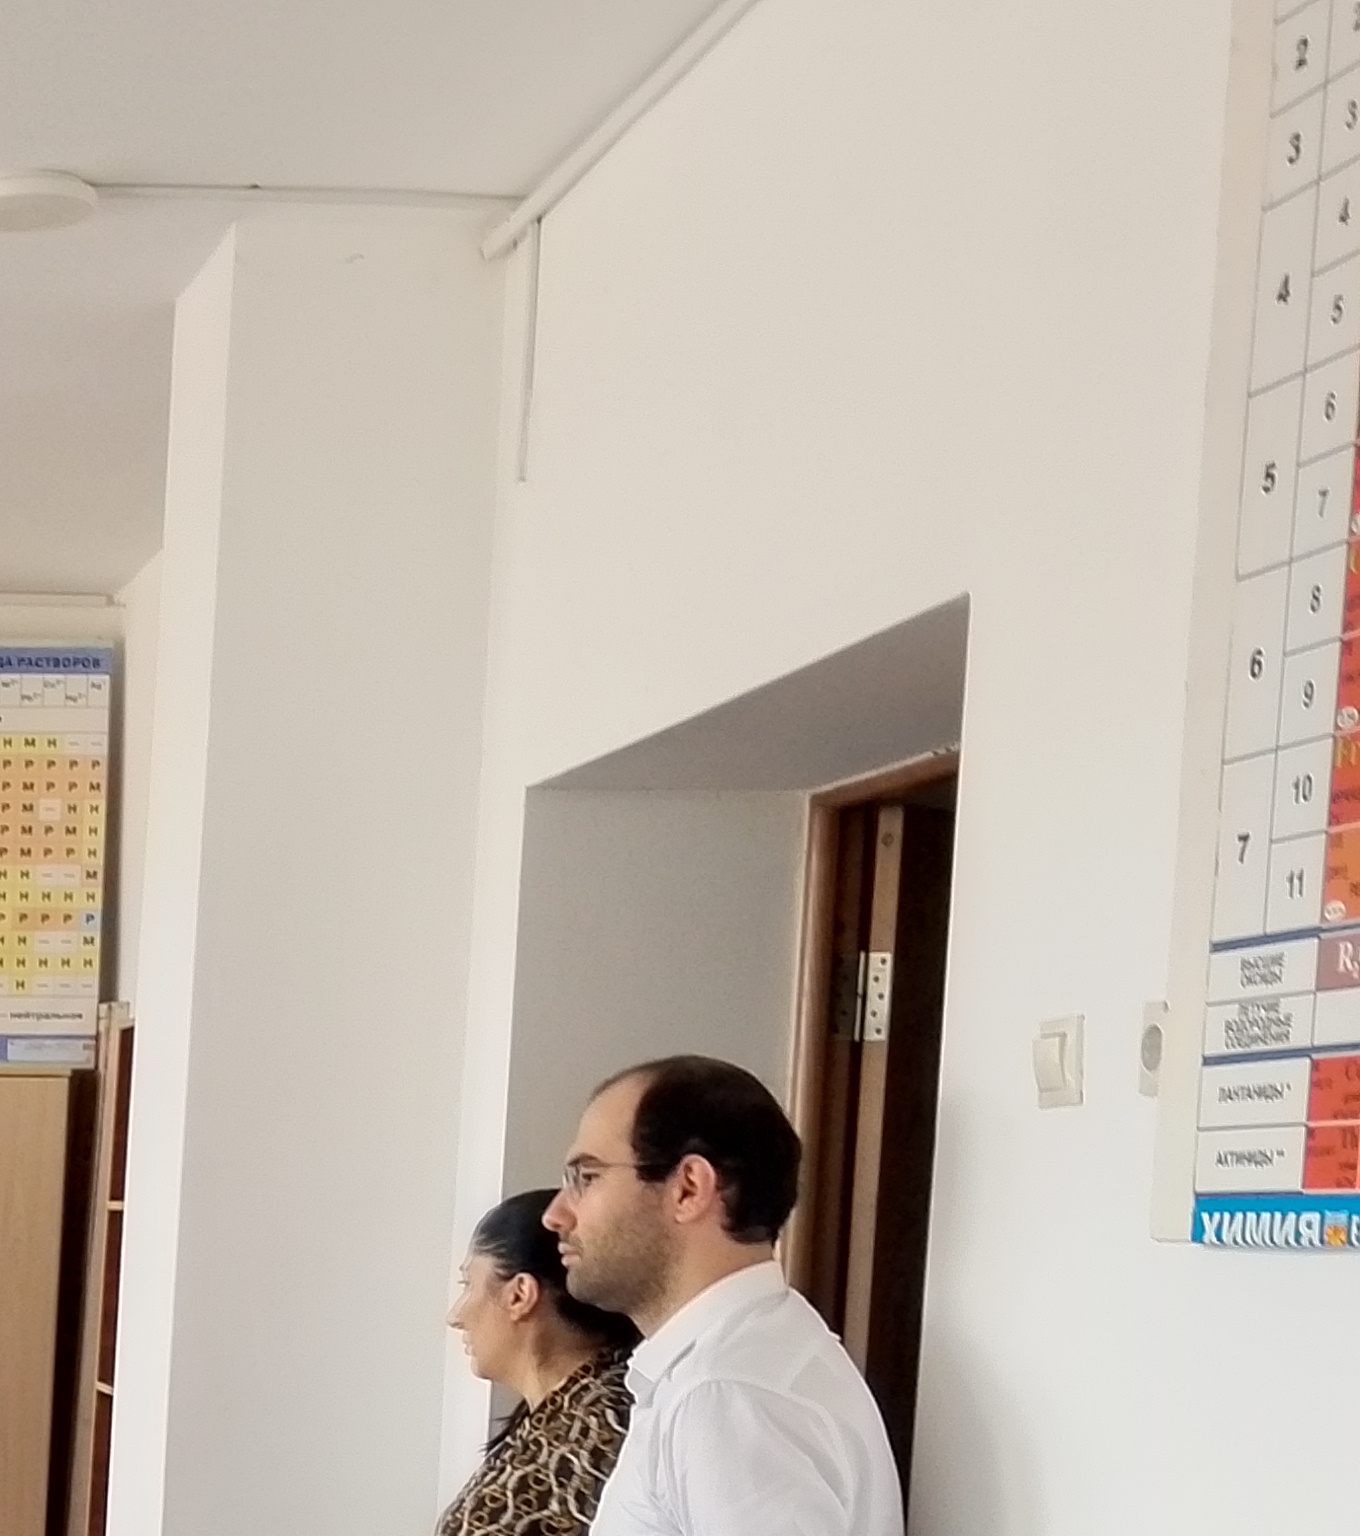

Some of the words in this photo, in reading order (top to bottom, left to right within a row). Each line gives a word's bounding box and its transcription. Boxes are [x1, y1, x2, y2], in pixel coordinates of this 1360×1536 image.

[1285, 131, 1302, 166] 3
[1337, 196, 1352, 227] 4
[1276, 273, 1291, 305] 4
[1323, 390, 1337, 422] 6
[1260, 461, 1278, 495] 5
[1317, 488, 1330, 518] 7
[1309, 584, 1322, 614] 8
[17, 657, 102, 669] РАСТВОРОВ
[1249, 646, 1264, 680] 6
[1302, 680, 1316, 708] 9
[1292, 773, 1313, 804] 10
[1236, 832, 1250, 864] 7
[1285, 868, 1305, 900] 11
[1201, 1211, 1322, 1247] ХИМИЯ
